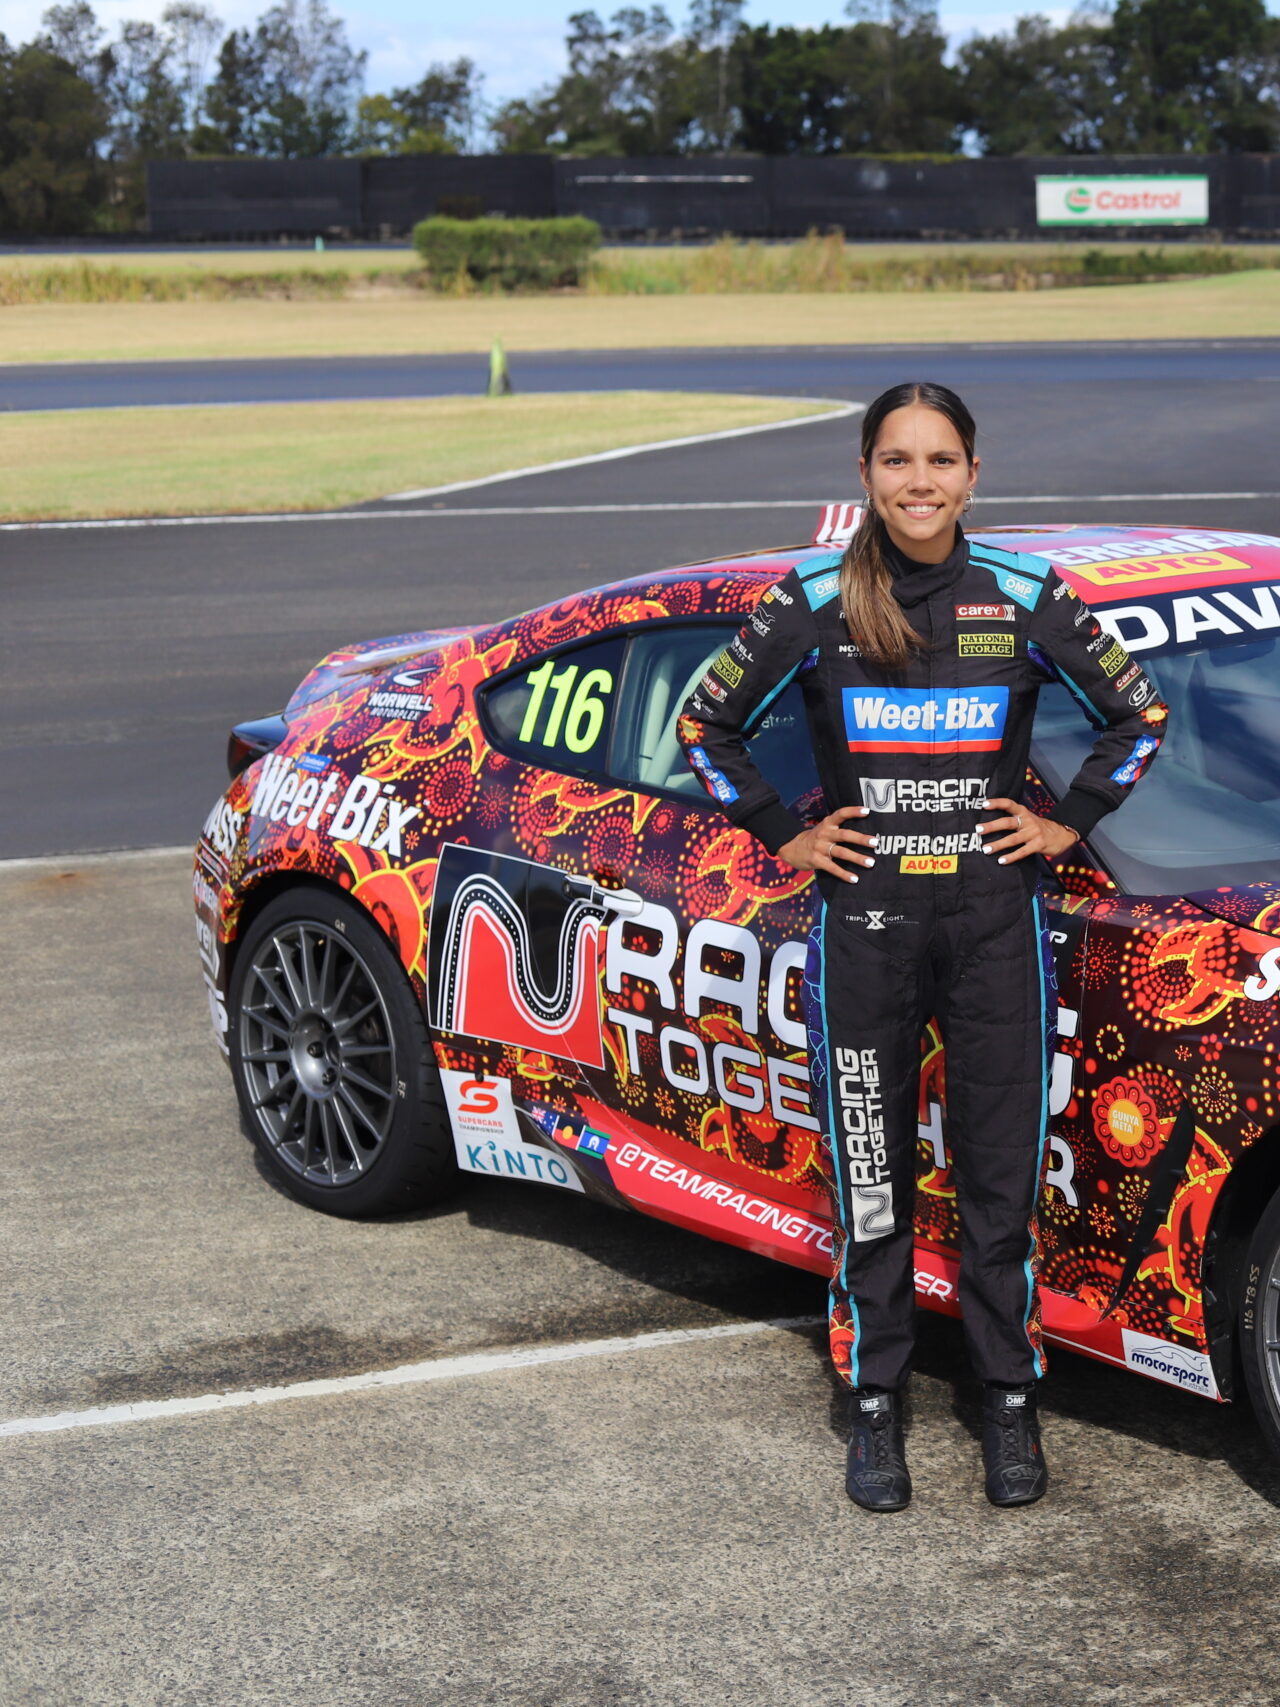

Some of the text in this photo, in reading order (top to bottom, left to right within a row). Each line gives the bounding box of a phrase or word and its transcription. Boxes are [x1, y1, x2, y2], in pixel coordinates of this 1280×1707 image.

[1096, 190, 1181, 210] Castrol
[1095, 556, 1224, 579] AUTO
[1005, 577, 1033, 596] OMP
[961, 634, 1013, 644] NATIONAL
[963, 644, 1011, 654] STORAGE
[368, 692, 433, 711] NORWELL
[519, 660, 613, 753] 116
[370, 707, 421, 721] MOTORPLEX
[852, 696, 1000, 730] Weet-Bix
[897, 778, 990, 799] RACIN
[250, 753, 422, 857] Weet-Bix
[897, 797, 986, 813] TOGETHE
[874, 832, 983, 855] SUPERCHEA
[905, 858, 952, 871] AUTO
[845, 914, 869, 923] TRIPLE
[883, 914, 905, 923] EIGHT
[457, 1116, 504, 1128] SUPERCARS
[835, 1047, 875, 1186] RACING
[860, 1048, 891, 1184] TOGETHER
[1112, 1109, 1140, 1127] GUNYA
[1112, 1119, 1134, 1134] META
[1131, 1352, 1209, 1387] motorsport
[860, 1400, 880, 1410] OMP
[1005, 1396, 1026, 1405] OMP
